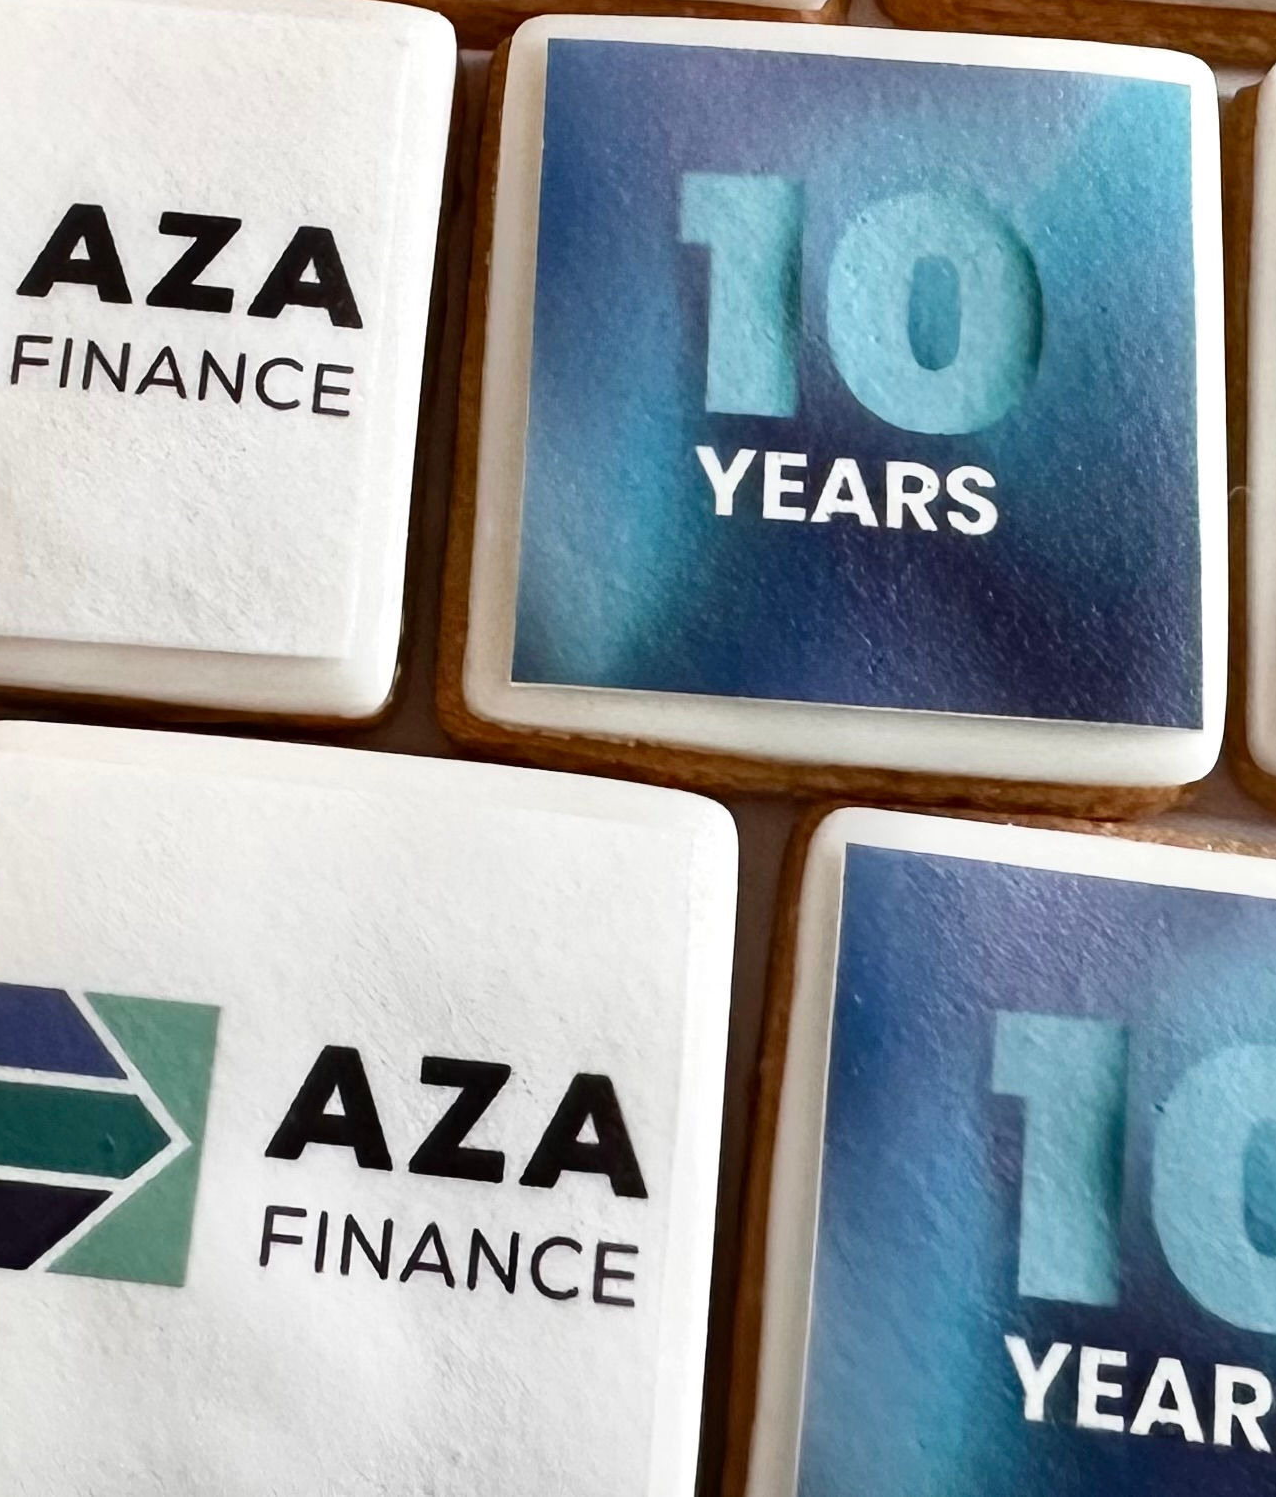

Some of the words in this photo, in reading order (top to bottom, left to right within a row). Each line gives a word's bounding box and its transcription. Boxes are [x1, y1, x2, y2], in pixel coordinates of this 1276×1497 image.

[16, 203, 364, 330] AZA
[679, 172, 1044, 435] 10
[10, 334, 354, 417] FINANCE
[696, 446, 998, 535] YEARS
[264, 1044, 649, 1200] AZA
[259, 1205, 639, 1308] FINANCE
